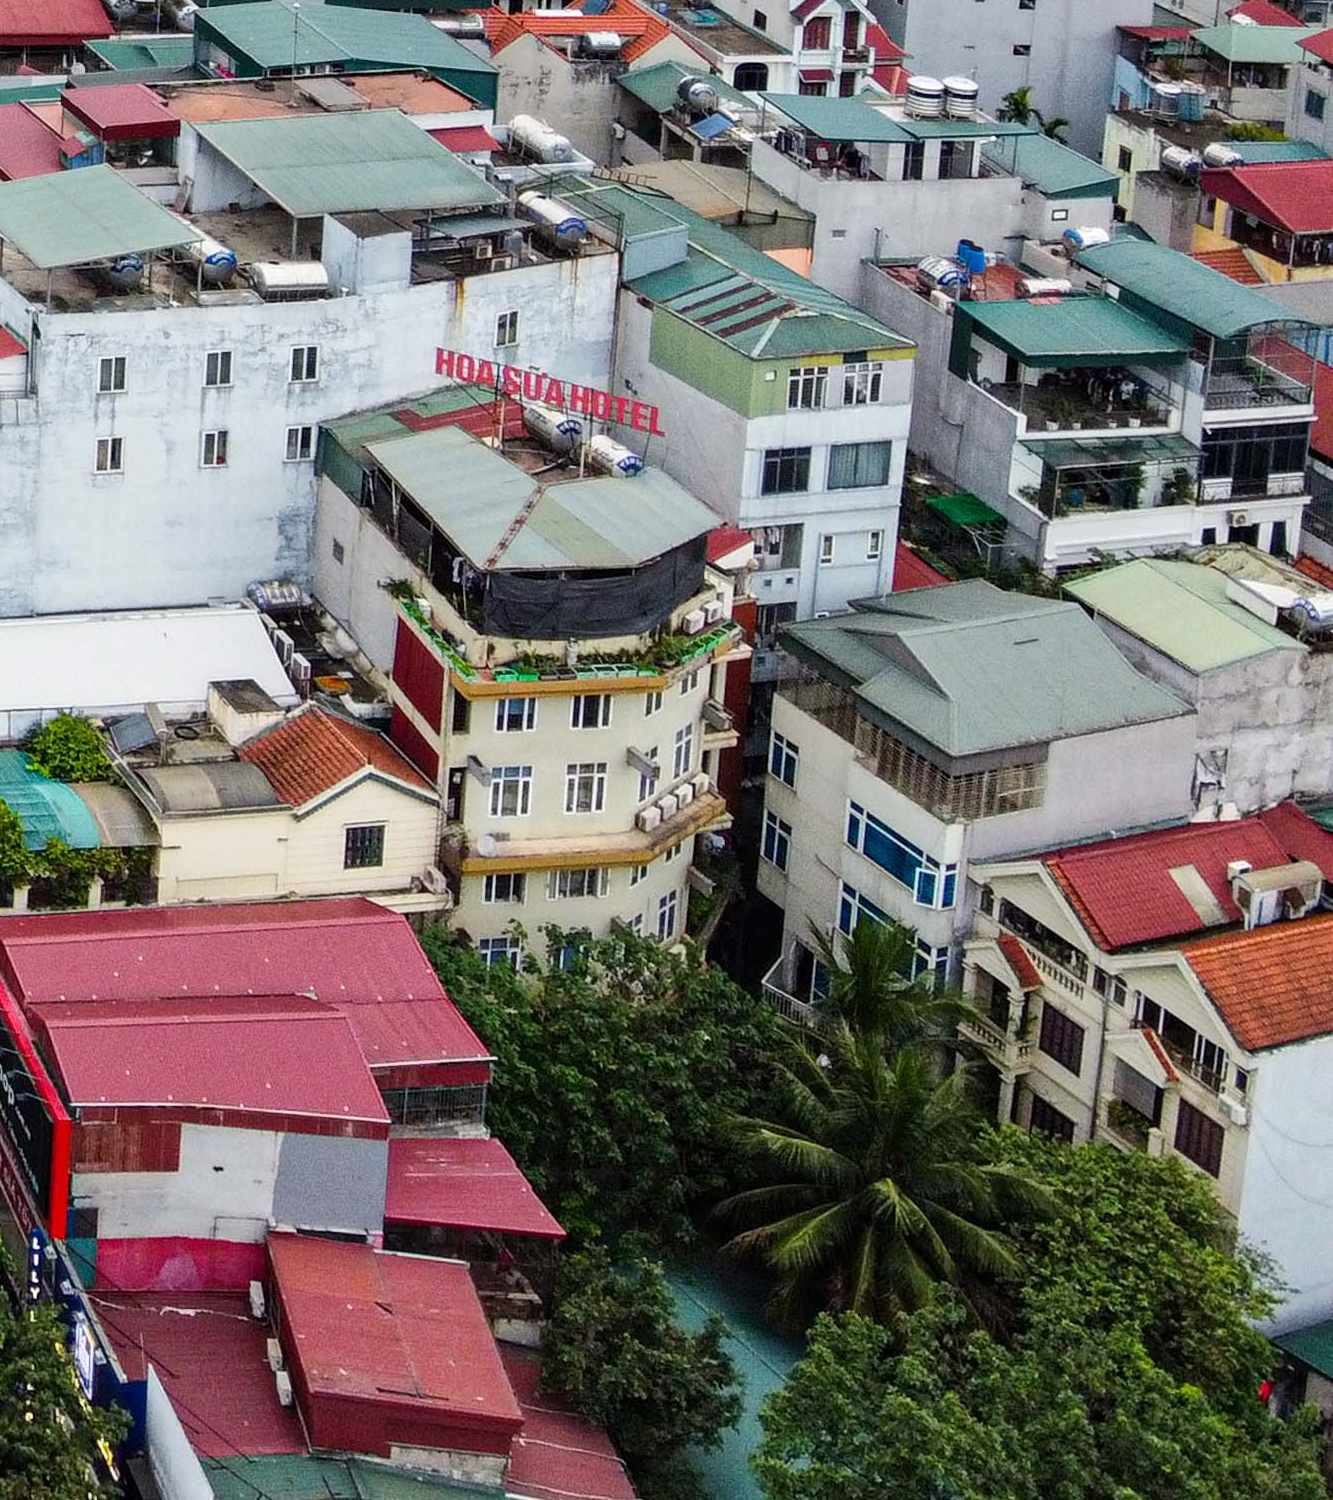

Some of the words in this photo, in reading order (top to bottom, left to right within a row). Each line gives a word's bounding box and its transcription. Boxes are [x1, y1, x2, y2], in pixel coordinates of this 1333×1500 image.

[435, 346, 496, 389] HOA
[501, 364, 564, 409] SỮA
[570, 383, 666, 437] HOTEL
[30, 1237, 41, 1300] LILY
